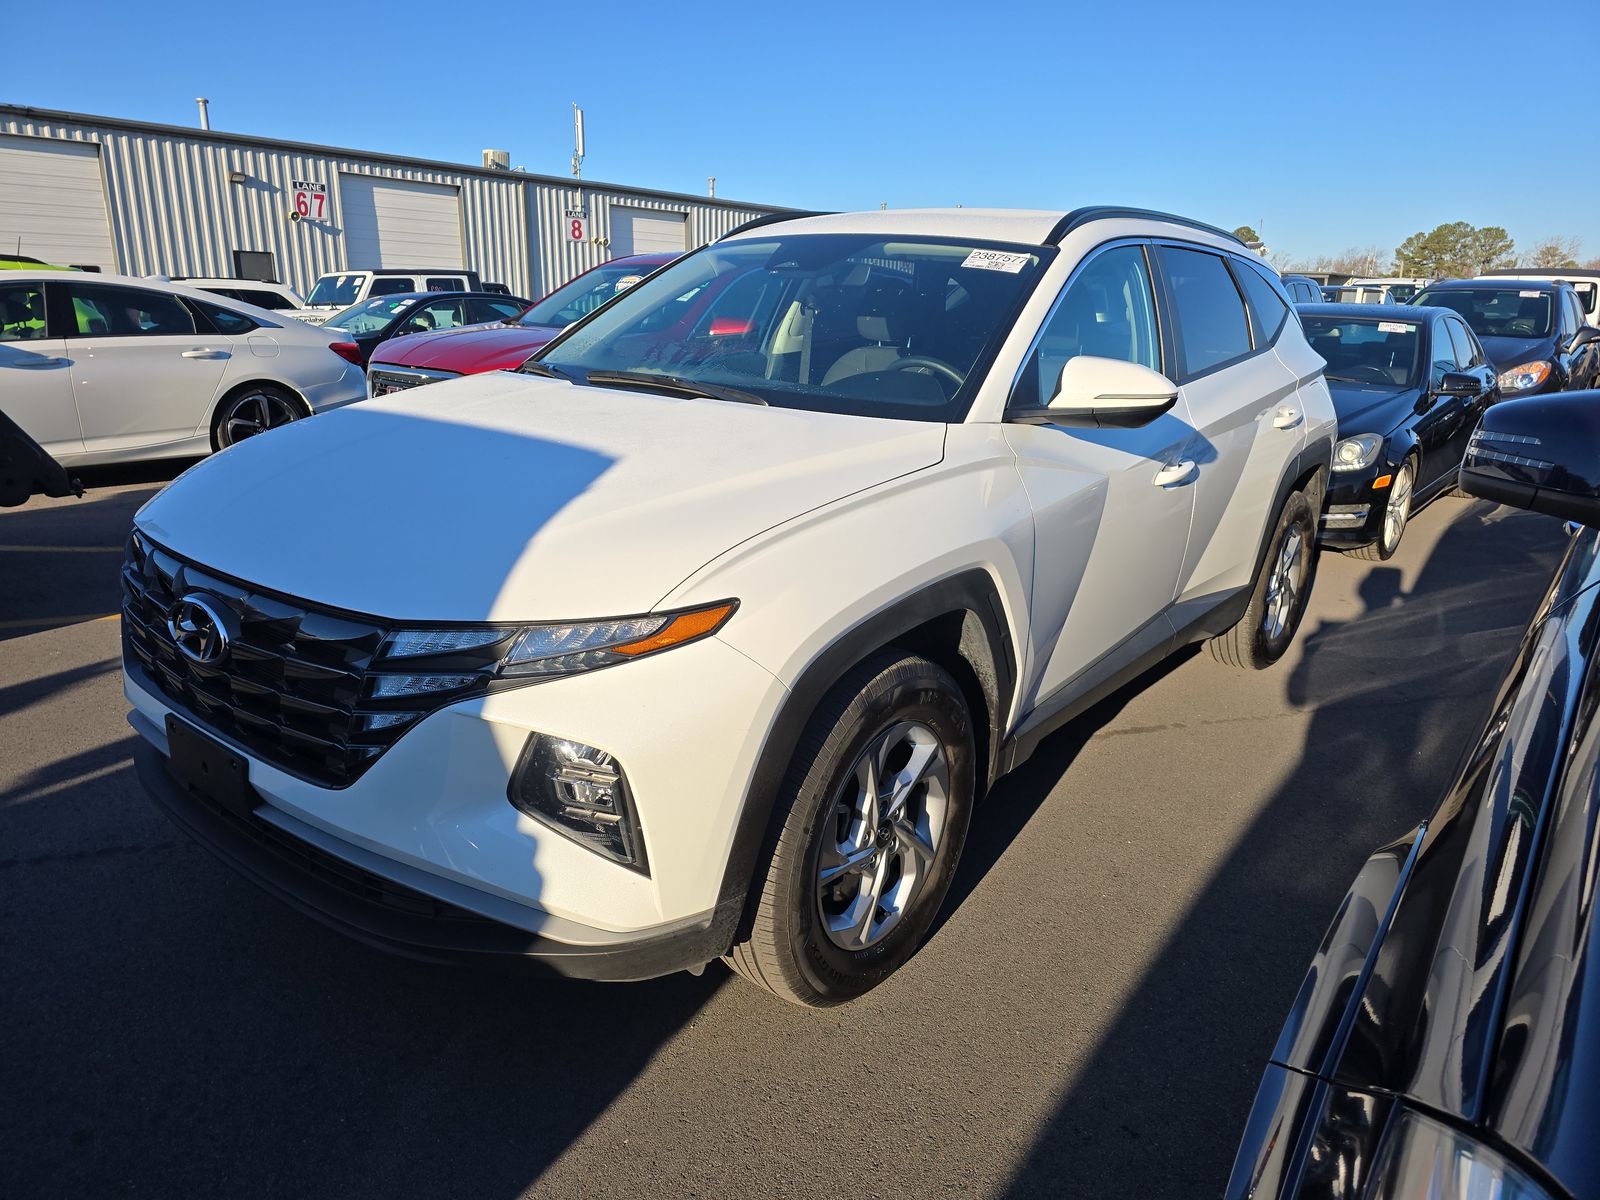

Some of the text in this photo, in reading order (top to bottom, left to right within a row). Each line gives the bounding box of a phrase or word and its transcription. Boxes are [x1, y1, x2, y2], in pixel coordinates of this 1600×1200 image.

[296, 183, 322, 191] LANE
[296, 192, 325, 217] 6/7
[567, 211, 584, 219] LANE
[571, 219, 583, 240] 8
[971, 251, 1028, 264] 2387577
